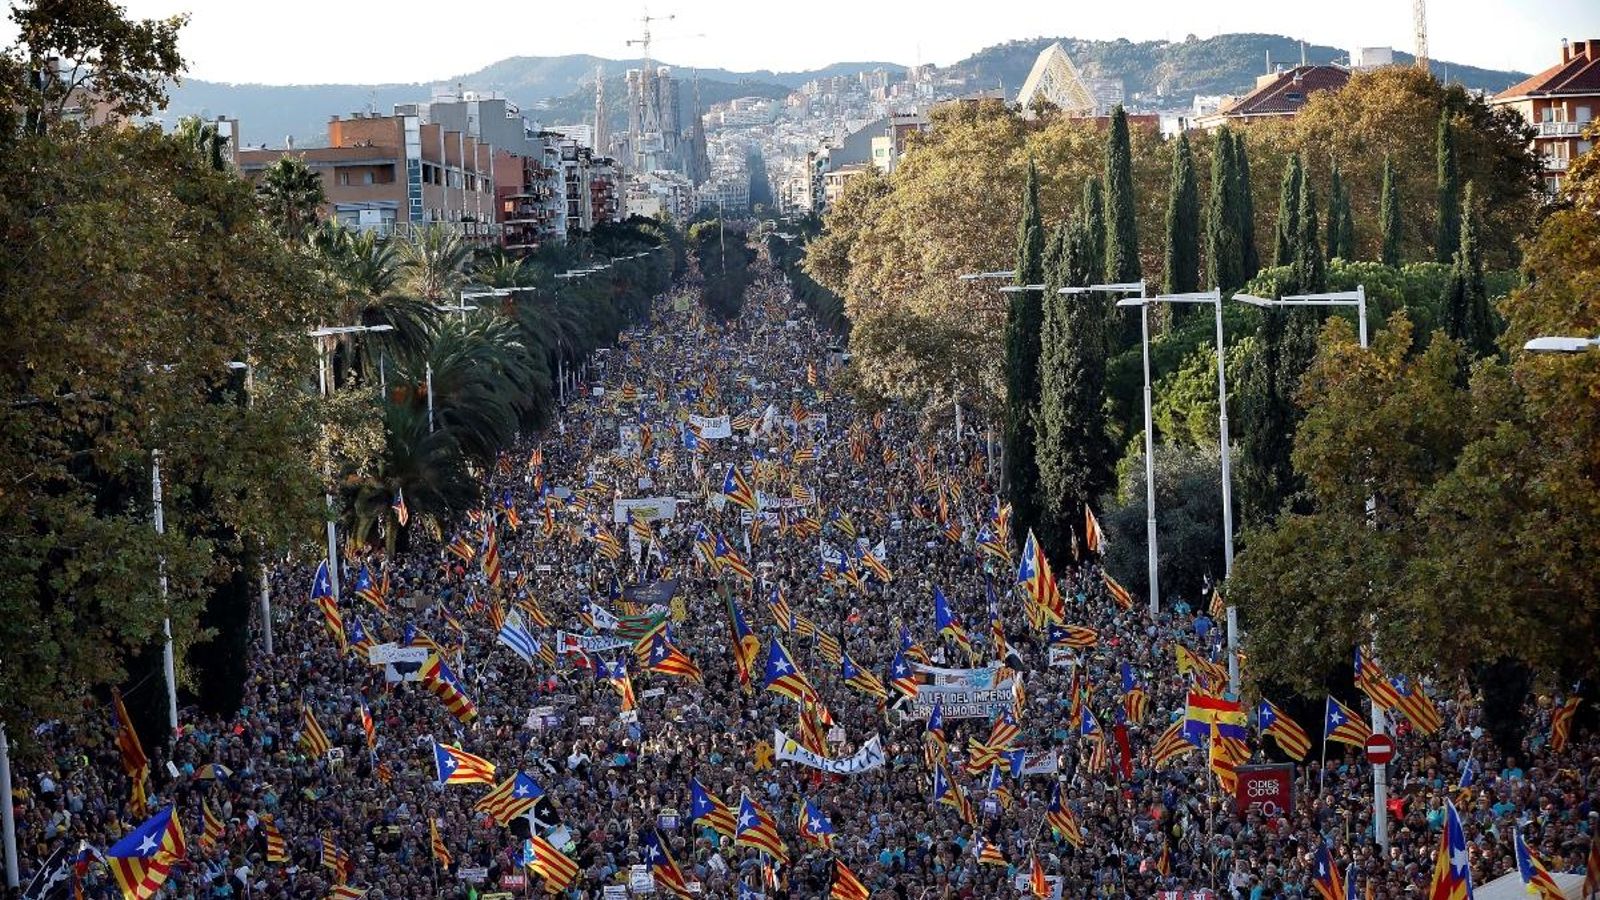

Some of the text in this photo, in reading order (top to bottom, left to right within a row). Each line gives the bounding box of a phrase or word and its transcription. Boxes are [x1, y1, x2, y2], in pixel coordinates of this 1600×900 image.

[929, 691, 946, 703] LEY
[951, 692, 969, 703] DEL
[974, 689, 1012, 703] IMPERIO
